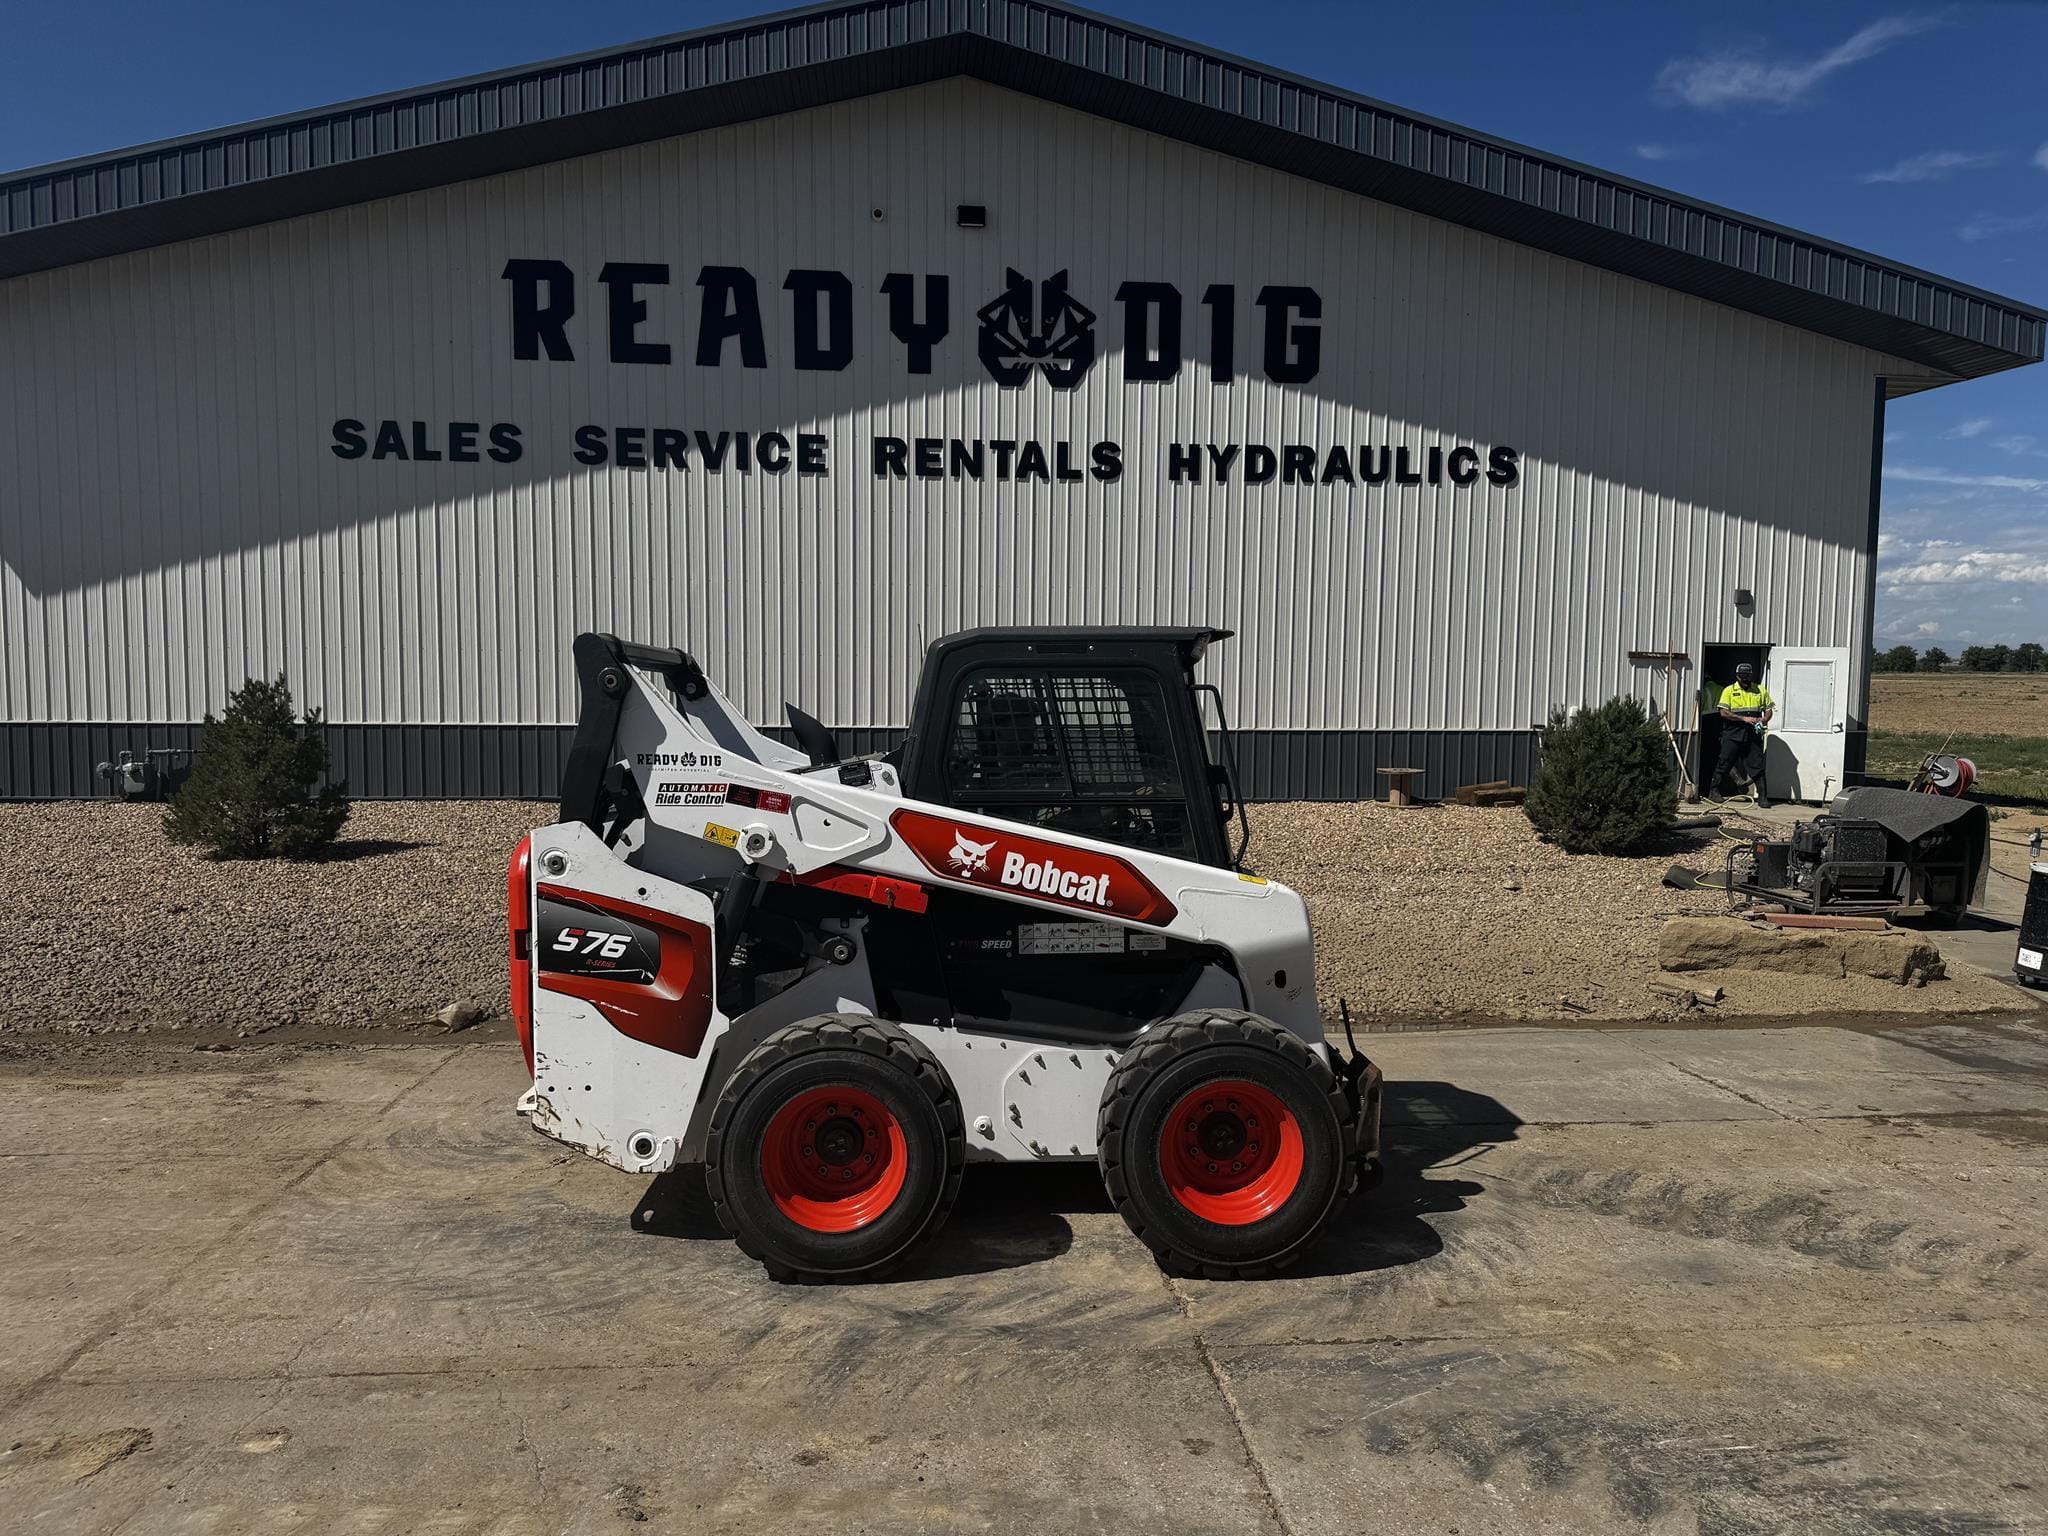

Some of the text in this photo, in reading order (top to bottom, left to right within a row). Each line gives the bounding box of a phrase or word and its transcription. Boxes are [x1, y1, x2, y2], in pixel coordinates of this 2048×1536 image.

[501, 259, 1323, 386] READY DIG
[331, 419, 1519, 486] SALES SERVICE RENTALS HYDRAULICS
[637, 753, 722, 767] READY DIG
[655, 793, 682, 804] Ride
[684, 793, 726, 805] Control
[661, 784, 726, 792] AUTOMATIC
[1001, 851, 1110, 906] Bobcat
[552, 928, 633, 958] S76
[980, 939, 1012, 949] SPEED
